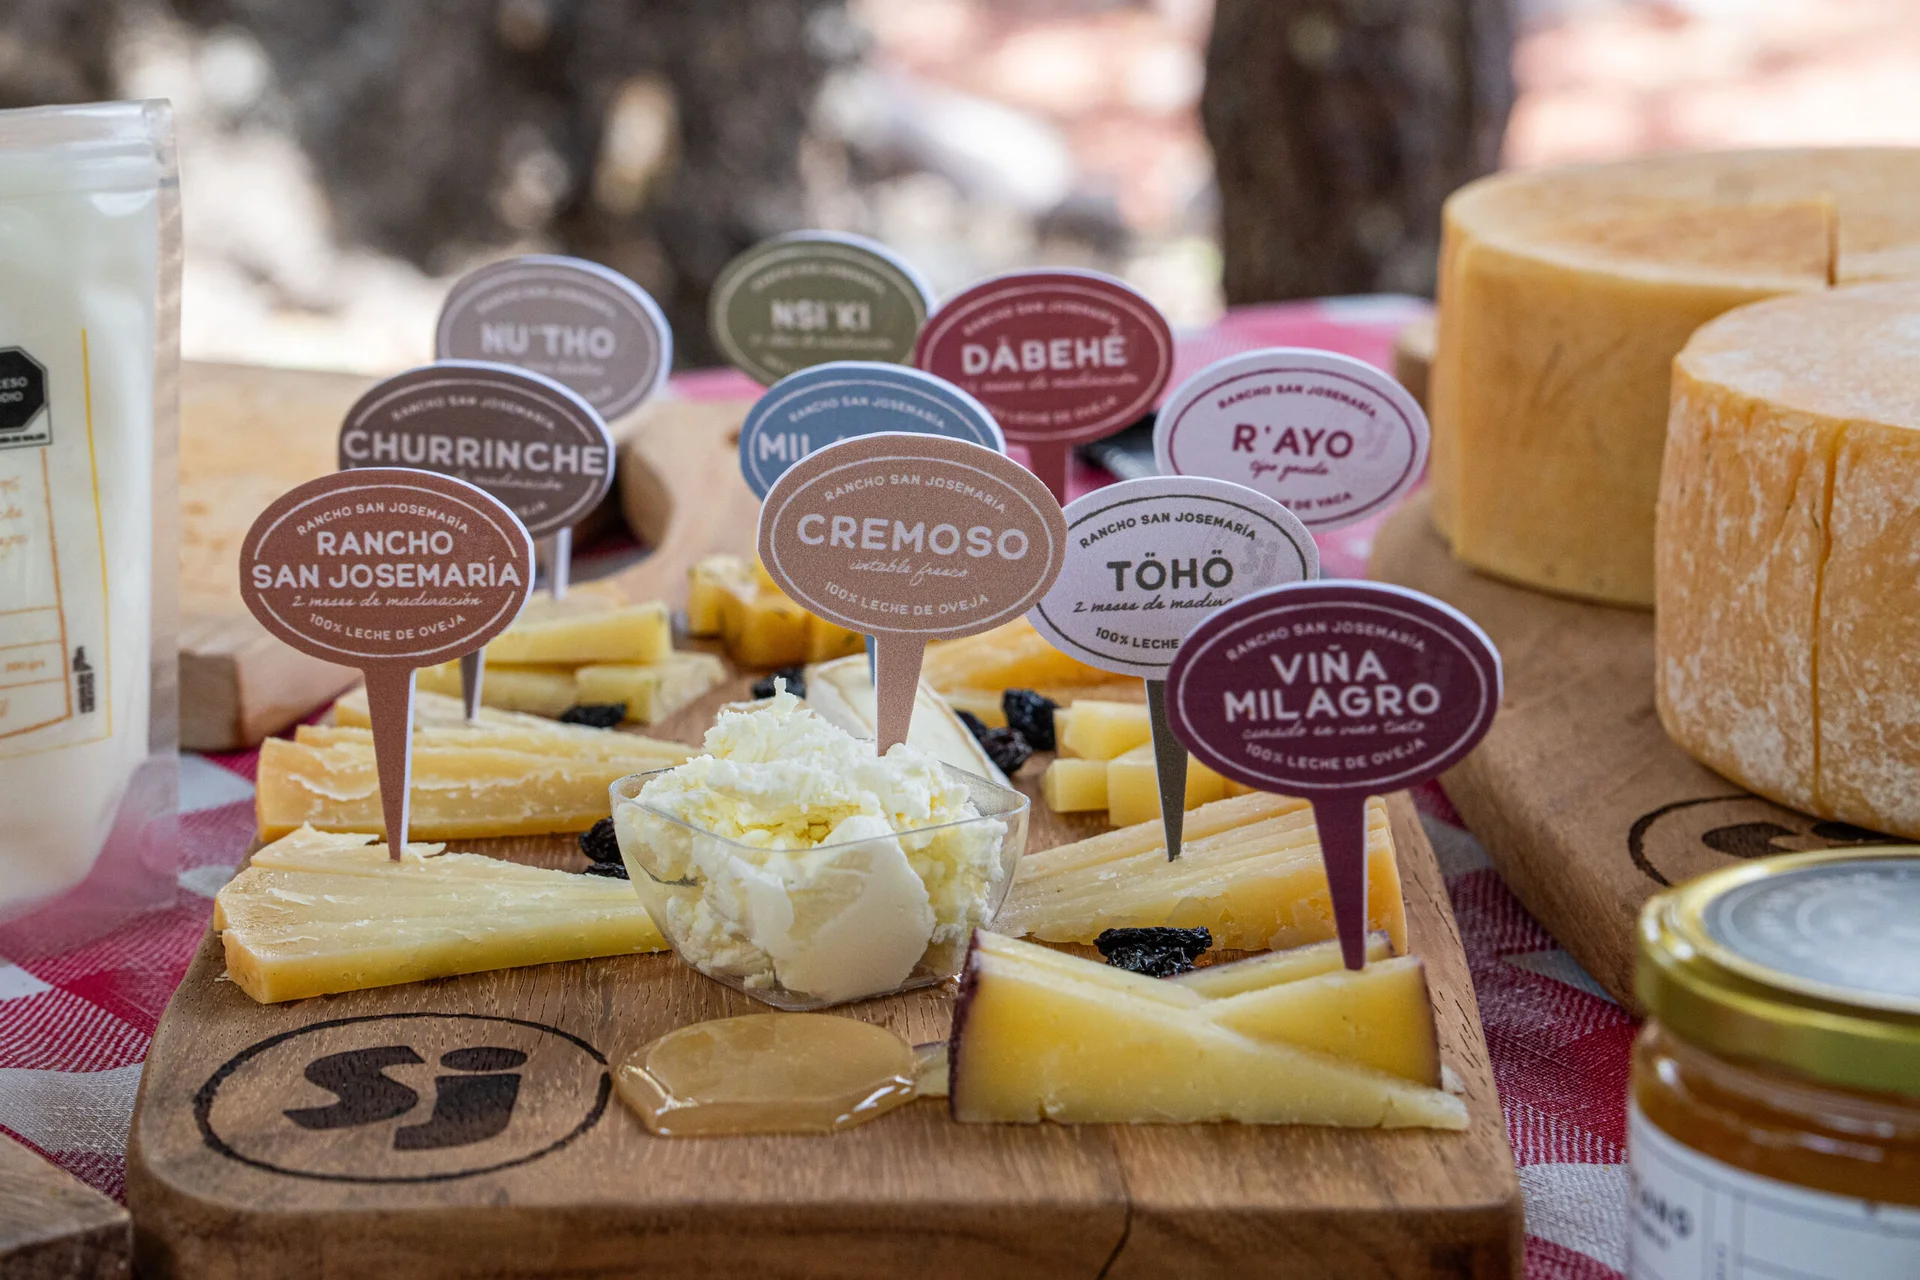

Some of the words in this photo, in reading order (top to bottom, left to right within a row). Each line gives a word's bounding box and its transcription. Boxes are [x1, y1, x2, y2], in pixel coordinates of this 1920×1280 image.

[842, 396, 869, 408] SAN
[1218, 385, 1272, 410] RANCHO
[1276, 384, 1303, 395] SAN
[342, 430, 606, 476] CHURRINCHE
[824, 476, 885, 502] RANCHO
[890, 474, 921, 486] SAN
[925, 475, 1006, 514] JOSEMARÍA
[296, 506, 351, 536] RANCHO
[356, 502, 384, 514] SAN
[389, 502, 468, 534] JOSEMARÍA
[1079, 518, 1137, 549] RANCHO
[1141, 512, 1171, 525] SAN
[1175, 512, 1256, 541] JOSEMARÍA
[316, 530, 454, 556] RANCHO
[797, 513, 1029, 560] CREMOSO
[252, 564, 320, 589] SAN
[328, 555, 522, 588] JOSEMARÍA
[1106, 549, 1234, 592] TÖHÖ
[292, 595, 306, 607] 2
[309, 598, 357, 607] meses
[360, 591, 381, 607] de
[385, 591, 482, 607] maduración
[825, 581, 857, 604] 100%
[861, 599, 908, 616] LECHE
[914, 604, 932, 616] DE
[938, 594, 989, 613] OVEJA
[1072, 601, 1087, 613] 2
[1090, 601, 1139, 612] meses
[1142, 594, 1165, 611] de
[309, 613, 342, 633] 100%
[345, 626, 391, 641] LECHE
[395, 629, 415, 640] DE
[418, 614, 466, 637] OVEJA
[1095, 626, 1128, 645] 100%
[1132, 637, 1180, 650] LECHE
[1226, 626, 1289, 661] RANCHO
[1293, 621, 1327, 636] SAN
[1331, 621, 1426, 654] JOSEMARÍA
[1270, 644, 1388, 685] VIÑA
[1223, 683, 1441, 722] MILAGRO
[1287, 754, 1341, 770] LECHE
[1345, 754, 1368, 769] DE
[1371, 738, 1428, 765] OVEJA
